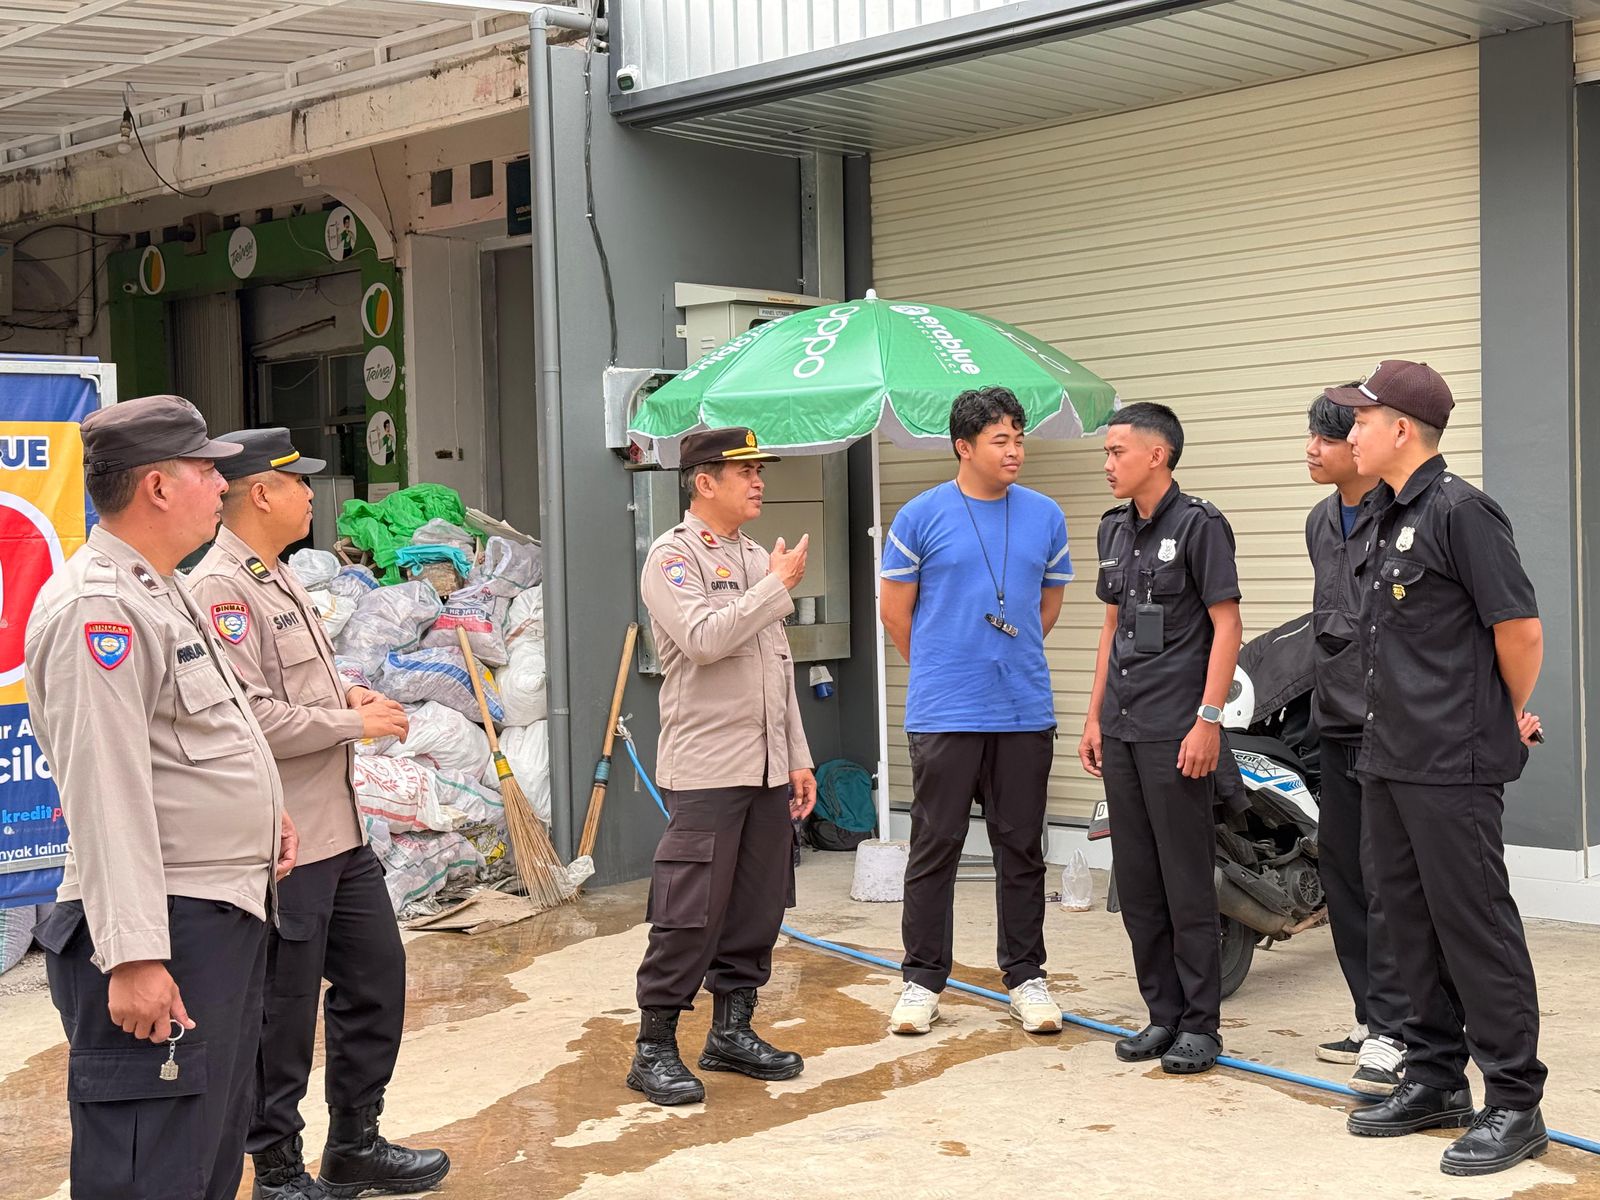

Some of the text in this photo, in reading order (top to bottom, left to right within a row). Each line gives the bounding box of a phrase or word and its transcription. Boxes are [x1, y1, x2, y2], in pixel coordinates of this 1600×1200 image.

[793, 305, 860, 378] oppo
[920, 315, 981, 375] erablue
[2, 804, 63, 823] kreditp
